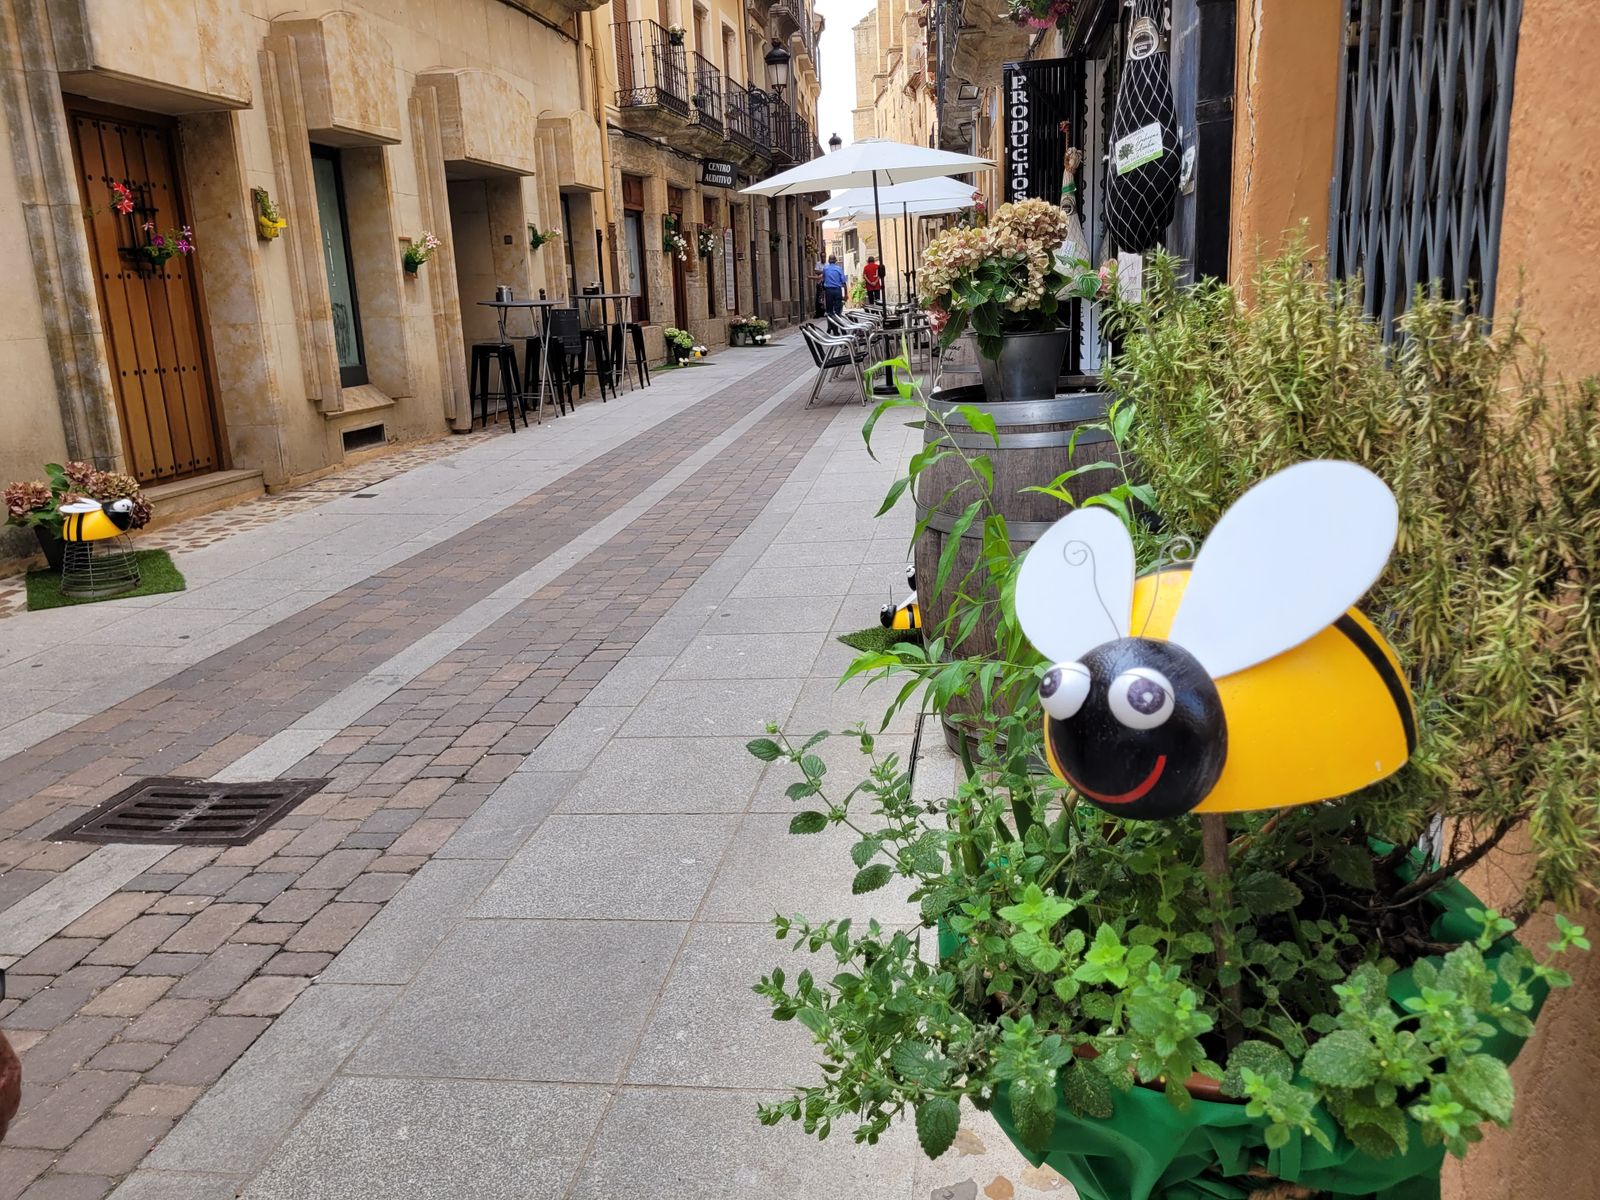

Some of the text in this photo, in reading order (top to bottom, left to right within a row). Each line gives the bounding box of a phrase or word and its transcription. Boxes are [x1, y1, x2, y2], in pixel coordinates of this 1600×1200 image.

[1010, 75, 1029, 206] PRODUCTOS
[708, 162, 731, 172] CENTRO
[705, 174, 732, 184] AUDITIVO
